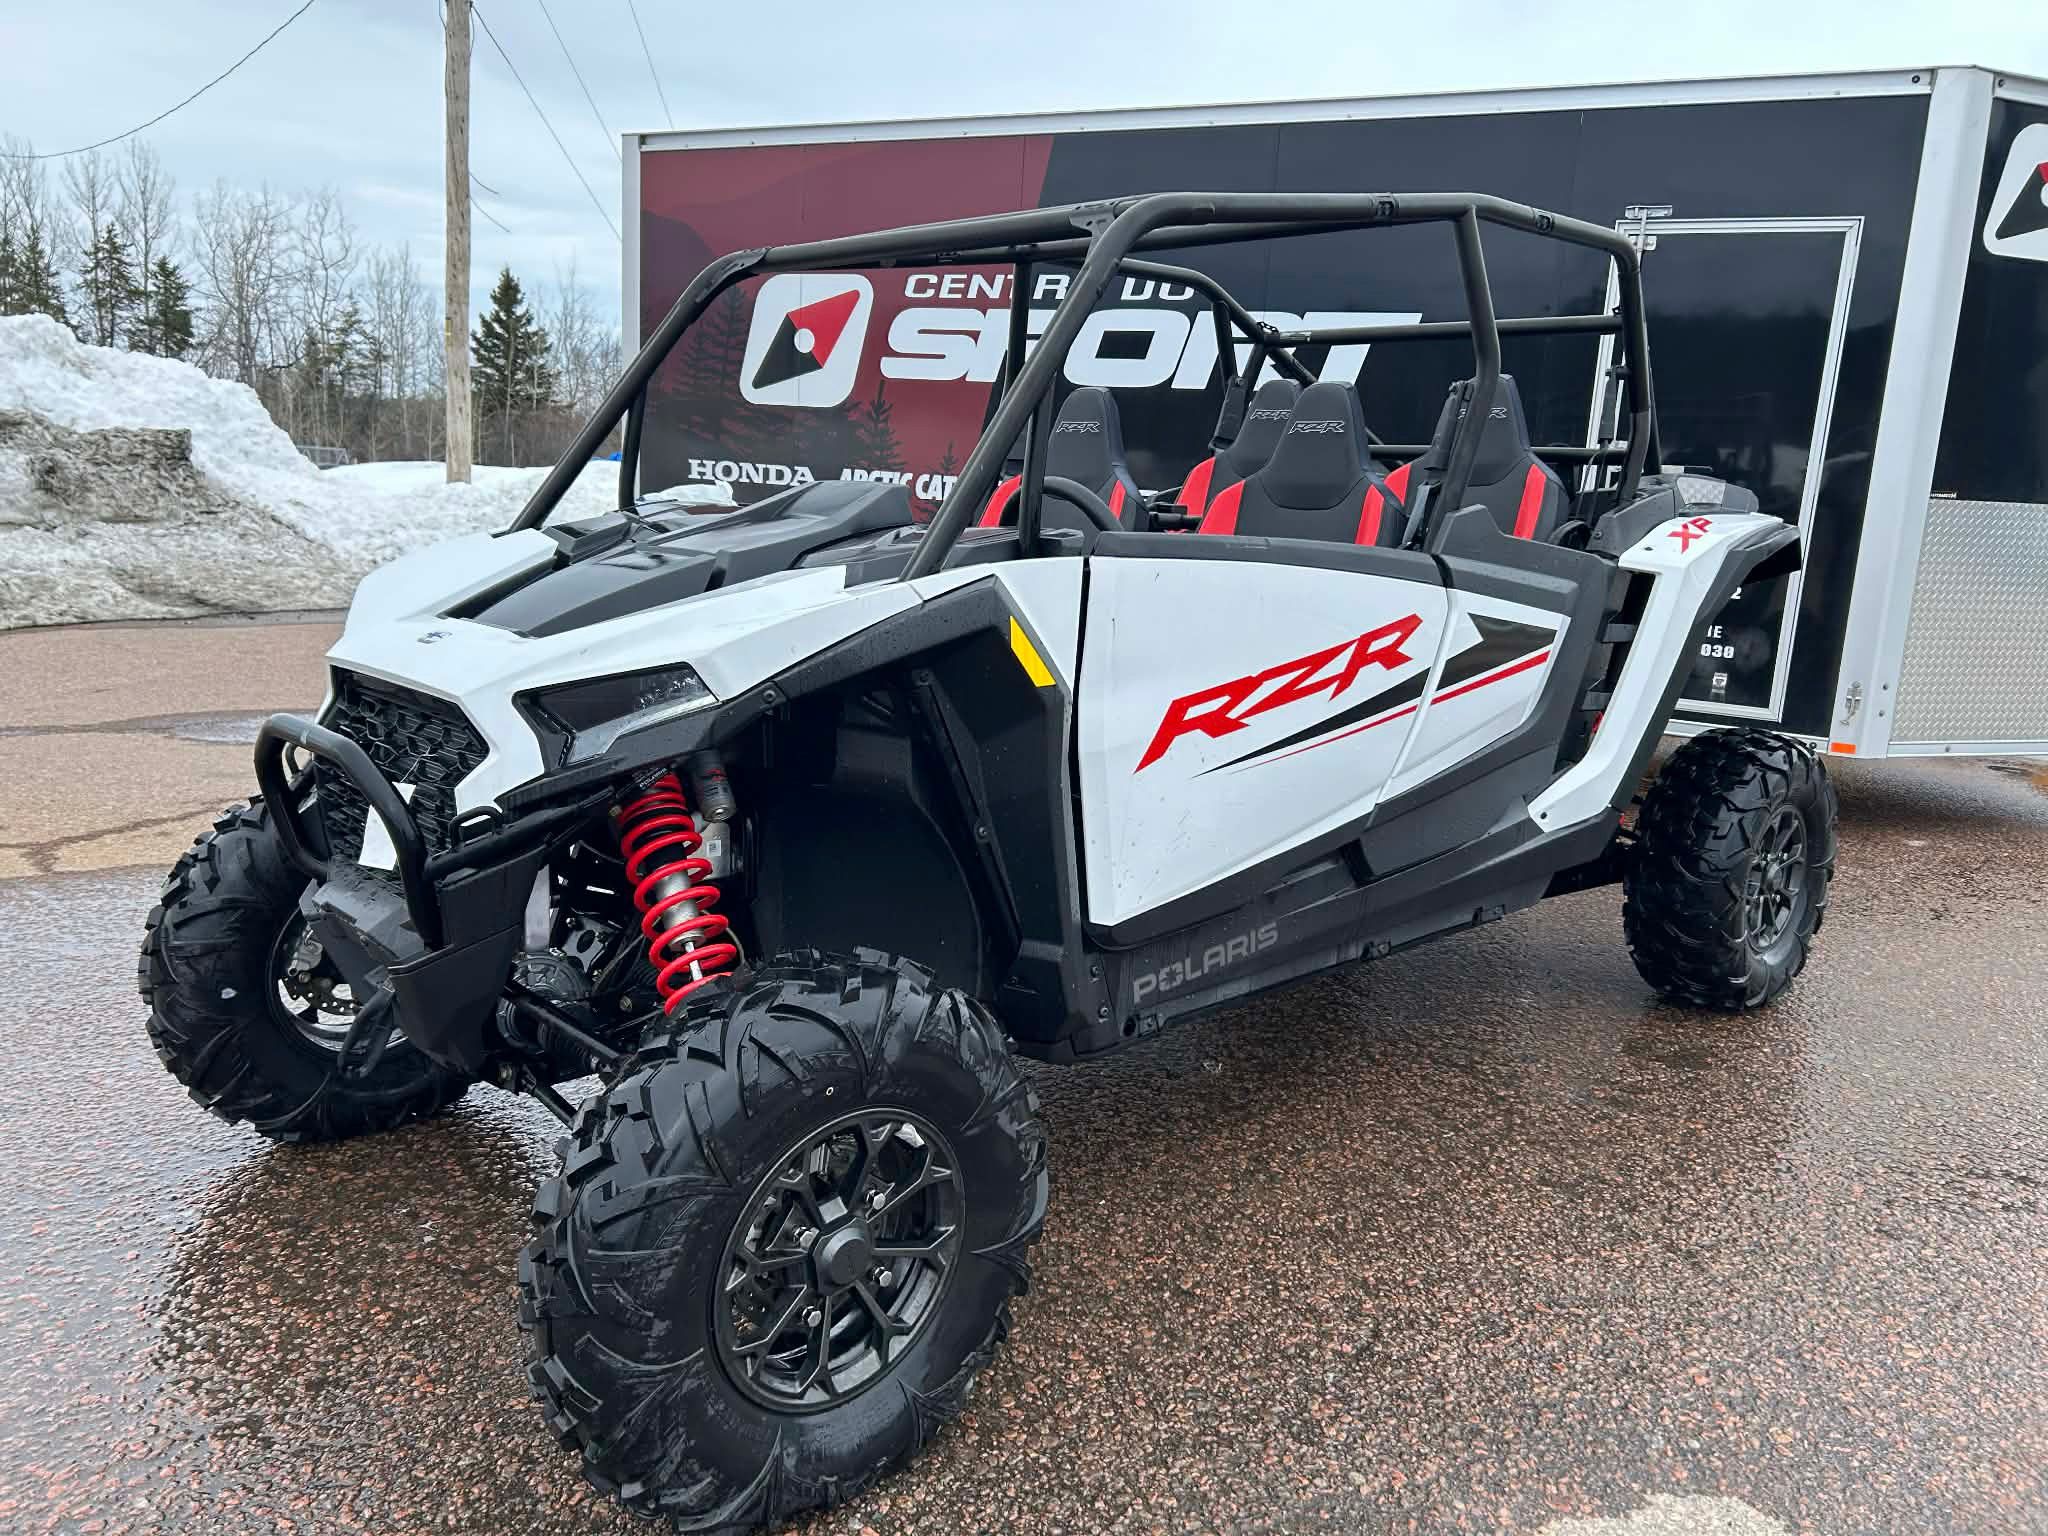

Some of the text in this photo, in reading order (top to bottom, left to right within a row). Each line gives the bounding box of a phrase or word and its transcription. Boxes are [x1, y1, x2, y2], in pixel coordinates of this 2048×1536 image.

[881, 307, 1423, 390] SPORT
[1055, 421, 1101, 433] RZR
[1288, 421, 1345, 434] RZR
[688, 458, 816, 487] HONDA
[1667, 517, 1712, 554] XP
[1133, 613, 1424, 775] RZR
[1133, 922, 1279, 1004] POLARIS
